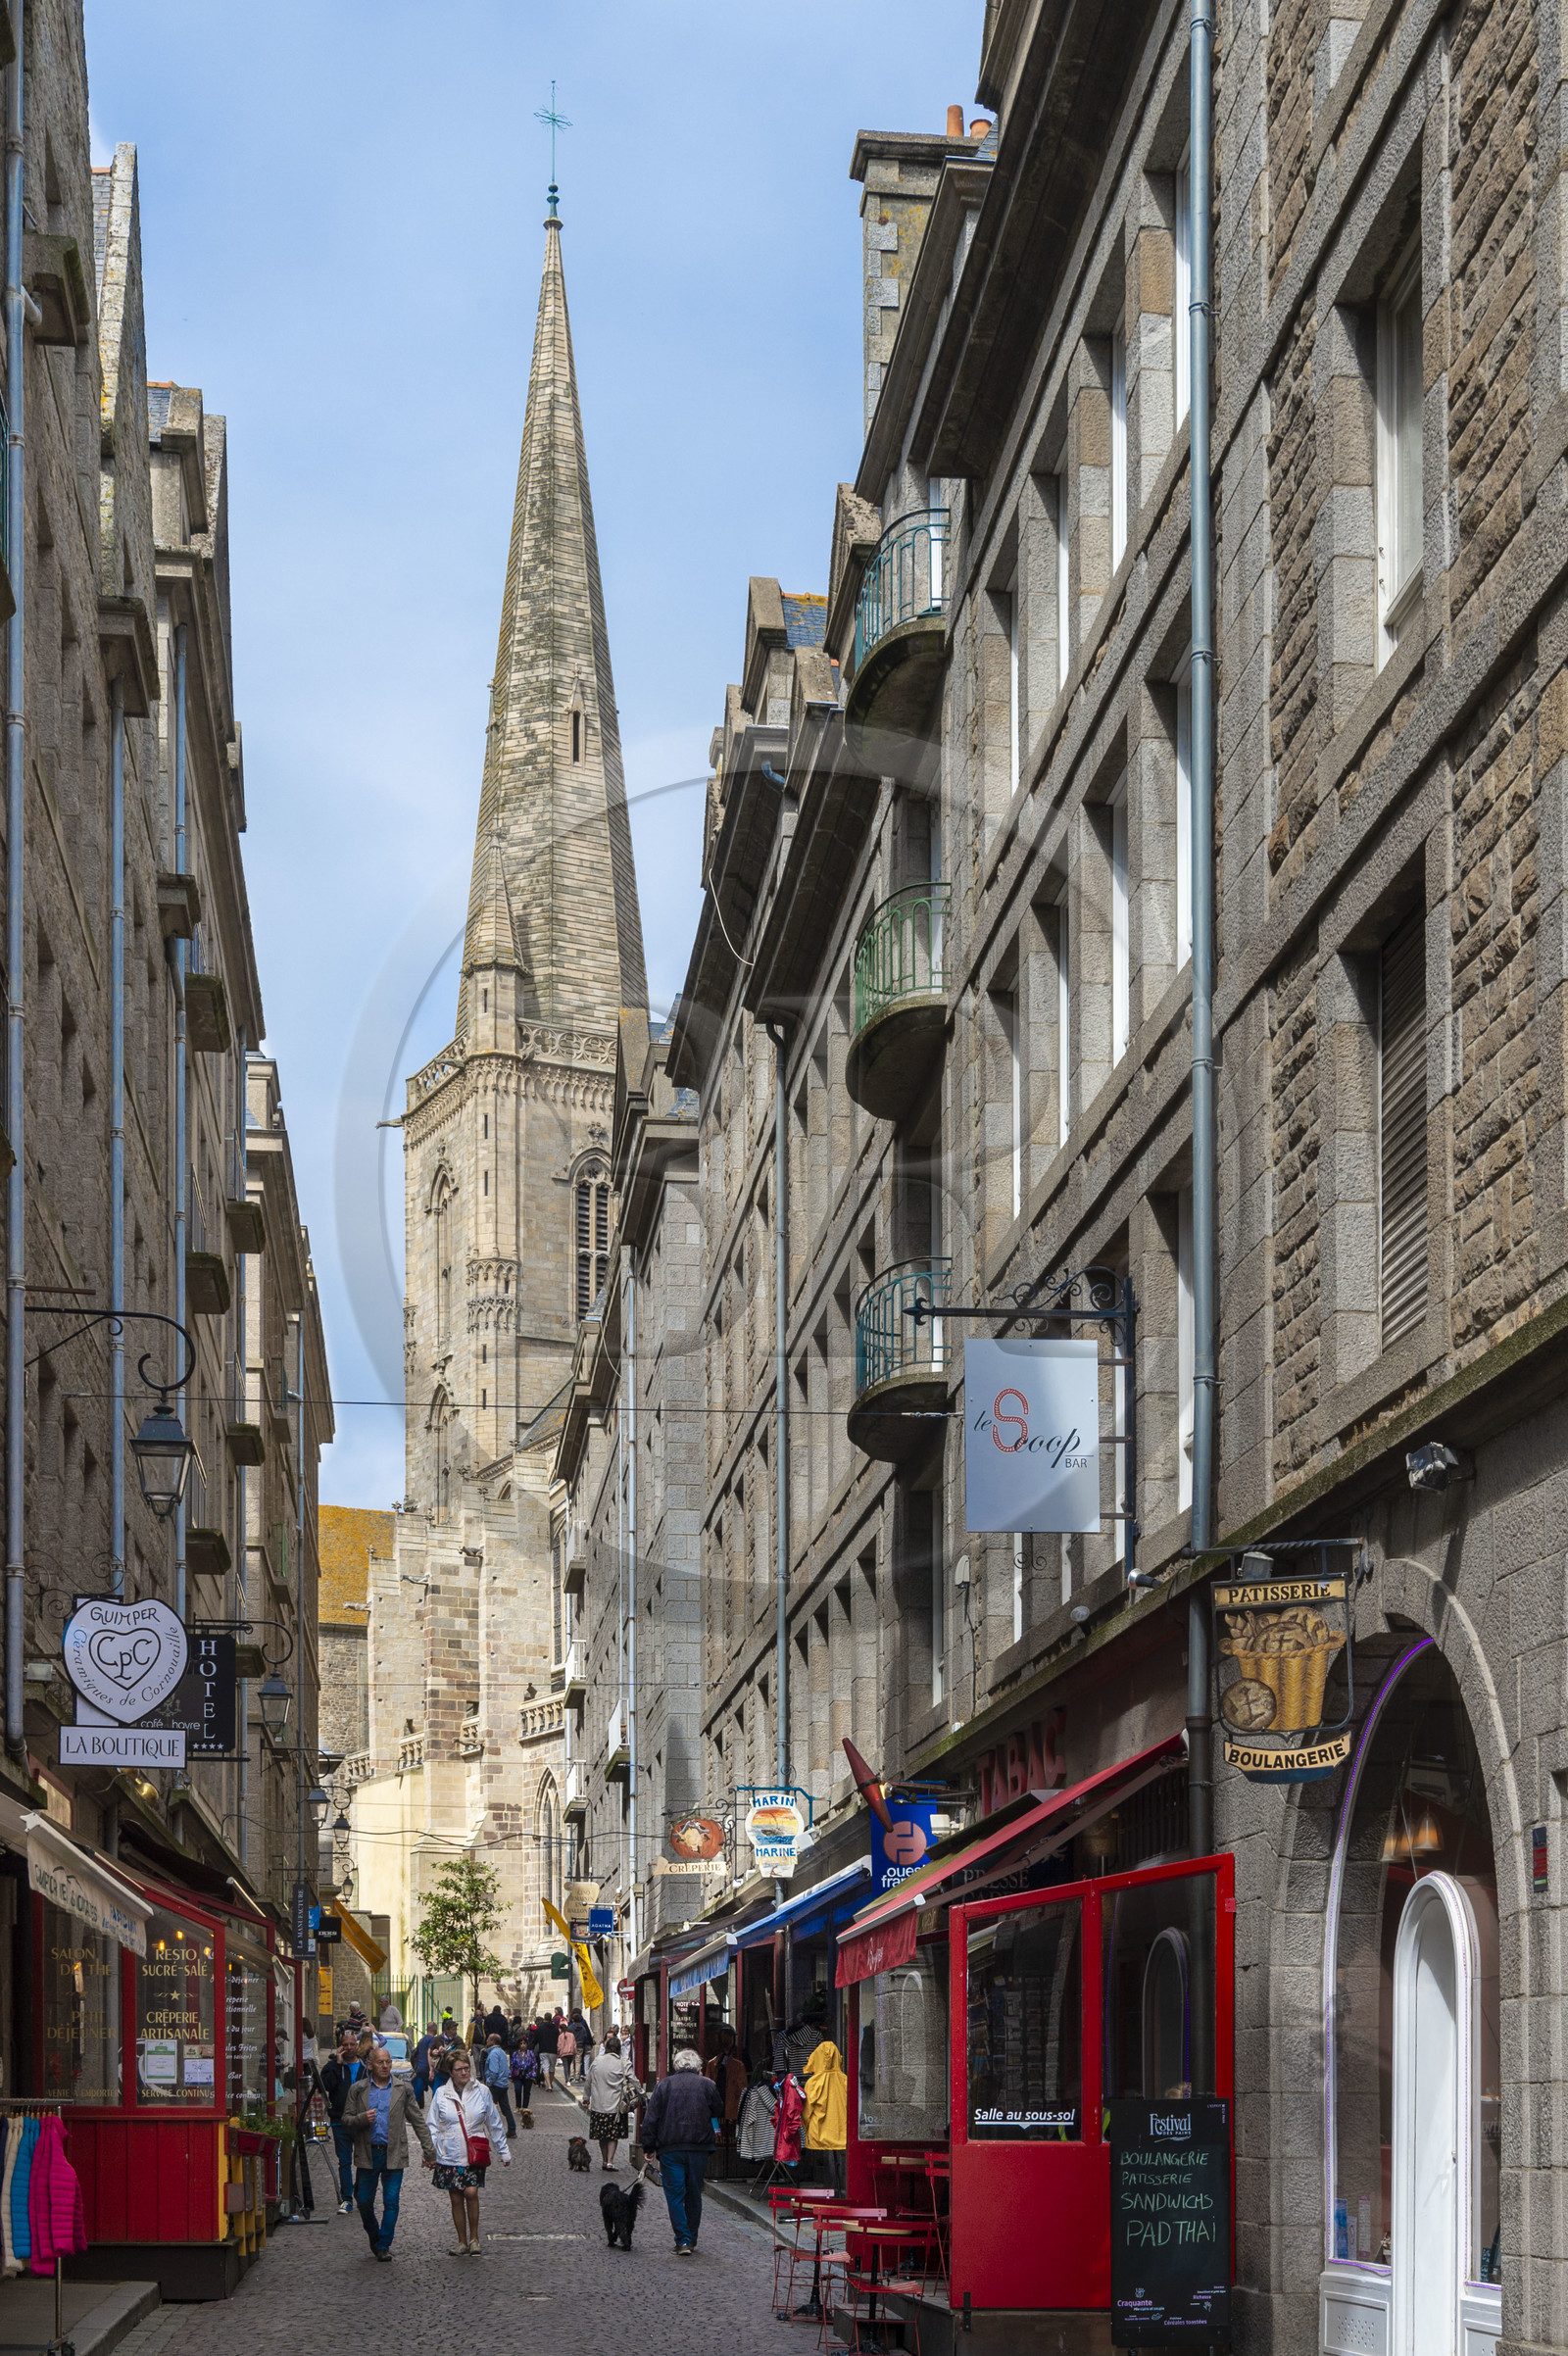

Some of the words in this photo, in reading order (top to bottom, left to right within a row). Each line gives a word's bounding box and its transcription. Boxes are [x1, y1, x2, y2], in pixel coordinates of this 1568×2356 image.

[974, 1410, 992, 1431] le
[992, 1388, 1081, 1468] Scoop
[1065, 1458, 1088, 1468] BAR
[1228, 1583, 1331, 1603] PATISSERIE
[119, 1692, 136, 1706] de
[141, 1626, 180, 1702] Cornouaille
[66, 1736, 88, 1755] LA
[91, 1736, 180, 1759] BOUTIQUE
[1228, 1742, 1347, 1769] BOULANGERIE
[978, 1709, 1066, 1817] TABAC
[753, 1795, 795, 1808] MARIN
[756, 1847, 797, 1857] MARINE
[887, 1865, 926, 1877] oues
[51, 1947, 96, 1960] SALON
[155, 1948, 197, 1960] RESTO
[146, 2008, 199, 2024] CRÊPERIE
[241, 2025, 256, 2034] jour
[238, 2043, 258, 2052] Frites
[48, 2088, 70, 2097] VENTE
[974, 2108, 1004, 2121] Salle
[1005, 2111, 1022, 2121] au
[1024, 2108, 1075, 2122] sous-sol
[1149, 2113, 1192, 2135] Festival
[1122, 2171, 1193, 2185] PATISSERIE
[1120, 2192, 1214, 2213] SANDWICHS
[1126, 2220, 1172, 2247] PAD
[1117, 2299, 1152, 2308] Craquante
